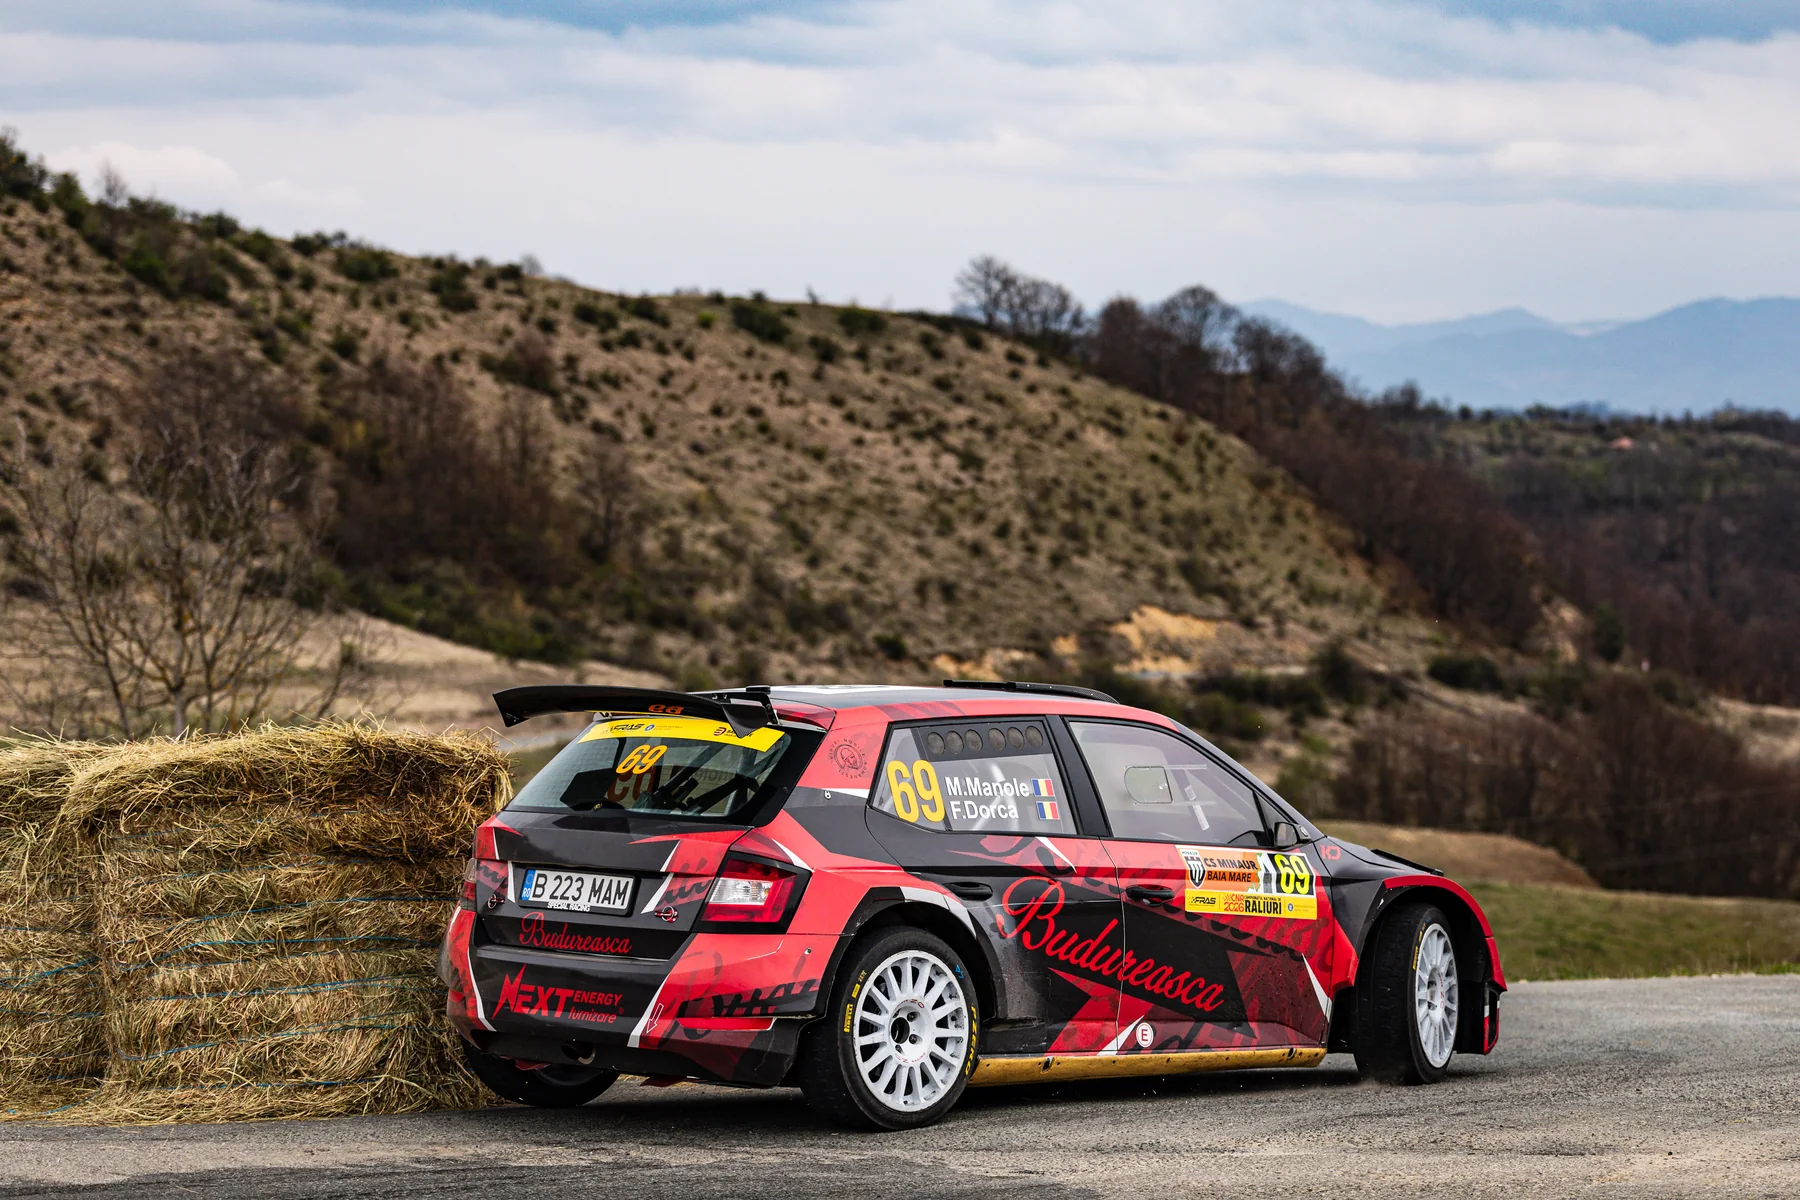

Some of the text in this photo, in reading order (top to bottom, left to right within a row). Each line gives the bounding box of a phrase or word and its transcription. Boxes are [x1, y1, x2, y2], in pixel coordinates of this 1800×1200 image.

[615, 744, 668, 775] 69
[886, 759, 946, 823] 69
[944, 776, 1030, 798] M.Manole
[950, 801, 1019, 820] F.Dorca
[1203, 857, 1258, 870] CS MINAUR
[1207, 871, 1252, 883] BAIA MARE
[1273, 853, 1310, 895] 69
[522, 887, 531, 899] RO
[532, 873, 630, 907] B 223 MAM
[1230, 893, 1245, 901] CNR
[547, 901, 591, 912] SPECIAL RACING
[1223, 902, 1245, 913] 2026
[1244, 899, 1282, 915] RALIURI
[519, 911, 633, 954] Budureasca
[996, 875, 1225, 1013] Budureasca
[491, 963, 623, 1020] NEXT ENERGY
[568, 1006, 617, 1024] furnizare
[1140, 1028, 1149, 1042] E
